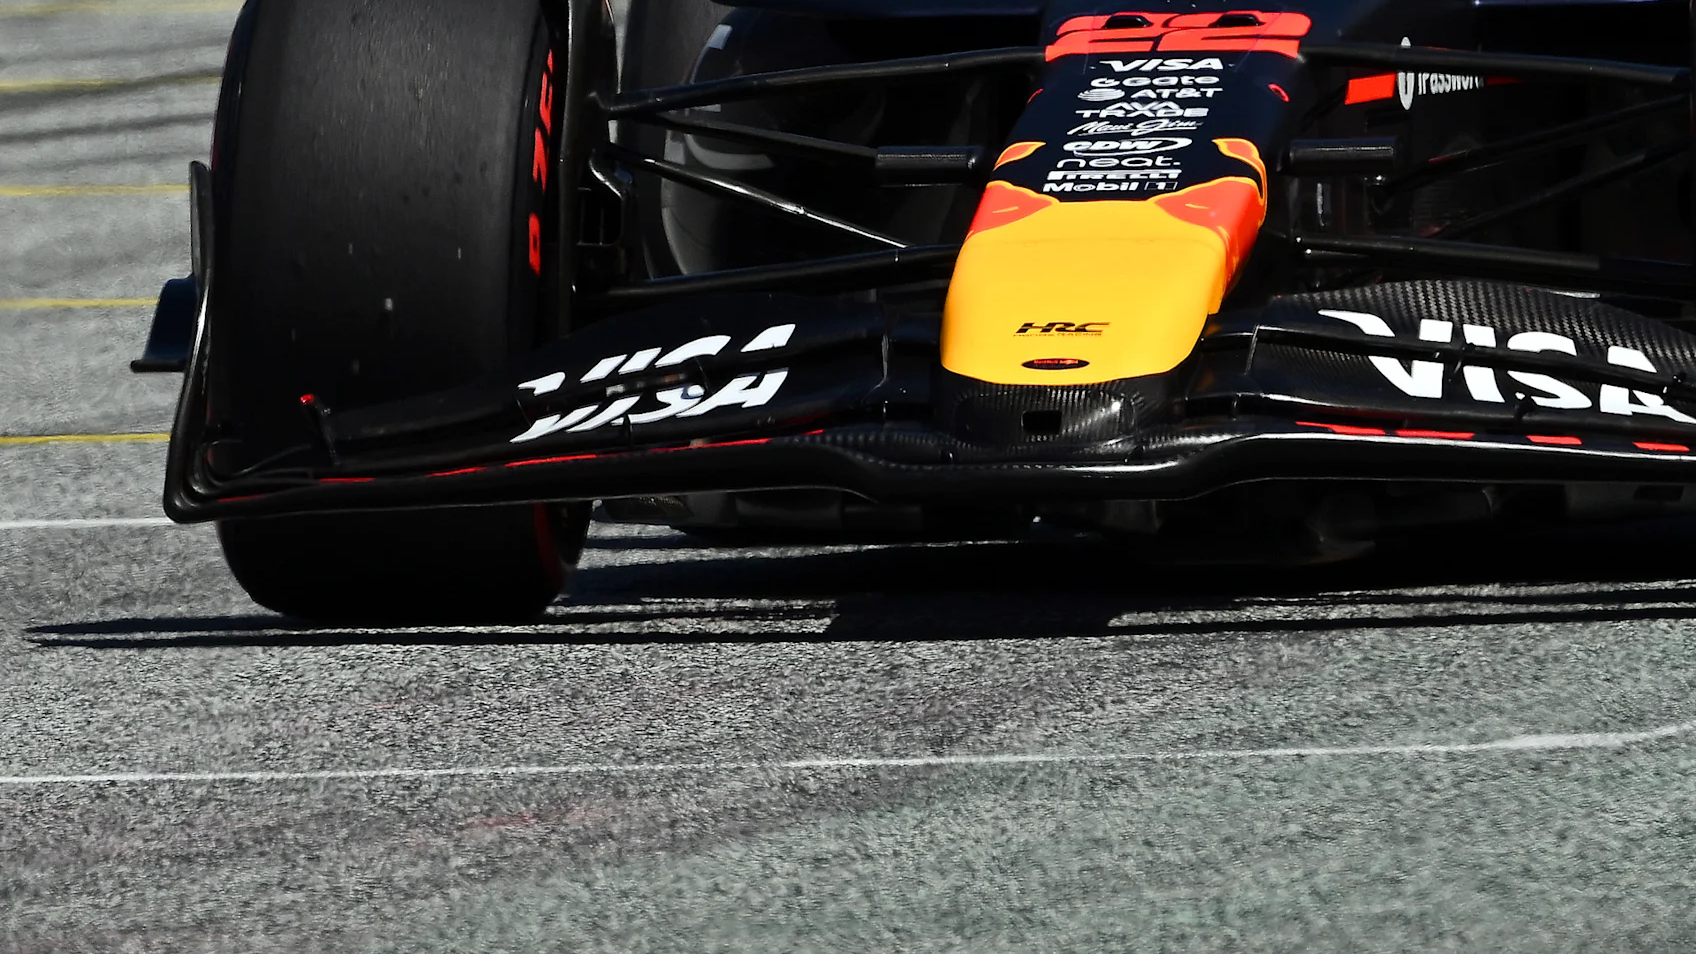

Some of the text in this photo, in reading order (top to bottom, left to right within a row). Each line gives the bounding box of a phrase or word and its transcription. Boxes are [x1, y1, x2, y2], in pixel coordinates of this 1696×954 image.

[1045, 10, 1313, 62] 22
[1100, 57, 1224, 72] VISA
[1122, 75, 1220, 87] Gate
[1131, 87, 1223, 99] AT&T
[1047, 168, 1182, 181] PIRELLI
[1043, 181, 1139, 193] Mobil
[1015, 321, 1110, 334] HRC
[509, 323, 797, 443] VISA
